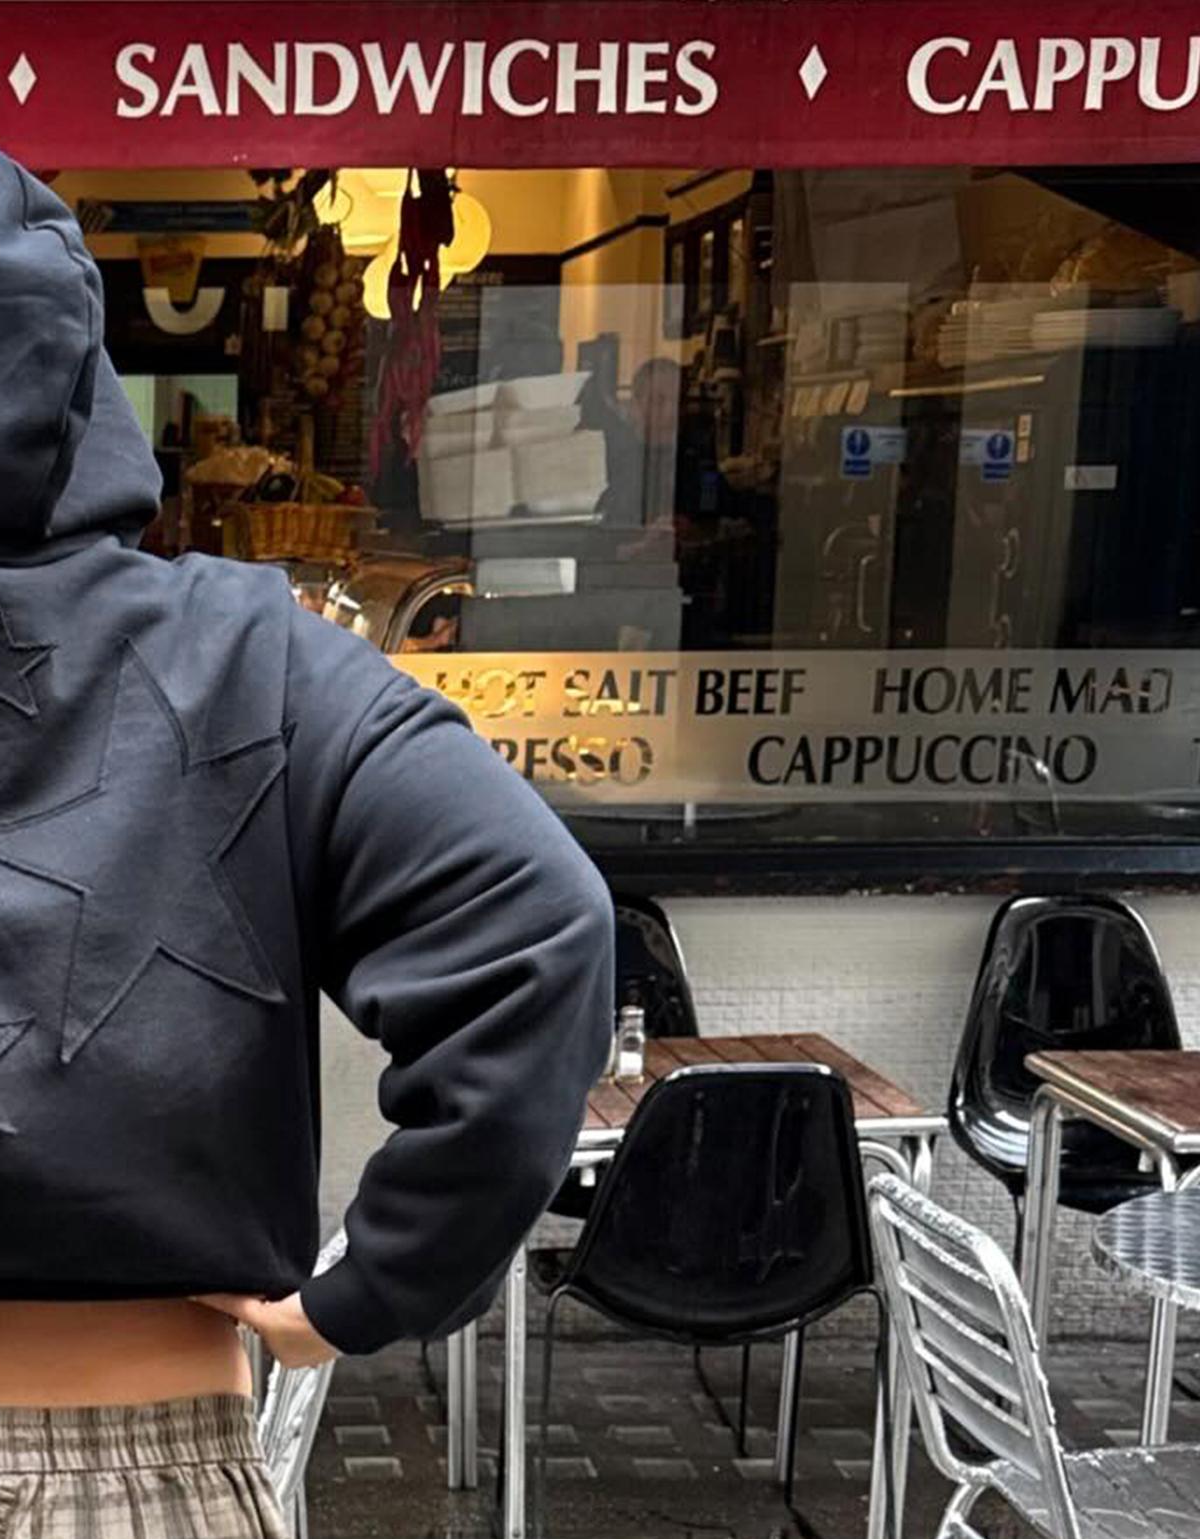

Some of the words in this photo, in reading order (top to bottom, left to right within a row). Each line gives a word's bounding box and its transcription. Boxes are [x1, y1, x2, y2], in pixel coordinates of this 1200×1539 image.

[114, 39, 718, 118] SANDWICHES
[906, 35, 1200, 114] CAPPU
[562, 668, 677, 718] SALT
[694, 668, 806, 716] BEEF
[872, 666, 1034, 715] HOME
[747, 734, 1099, 786] CAPPUCCINO
